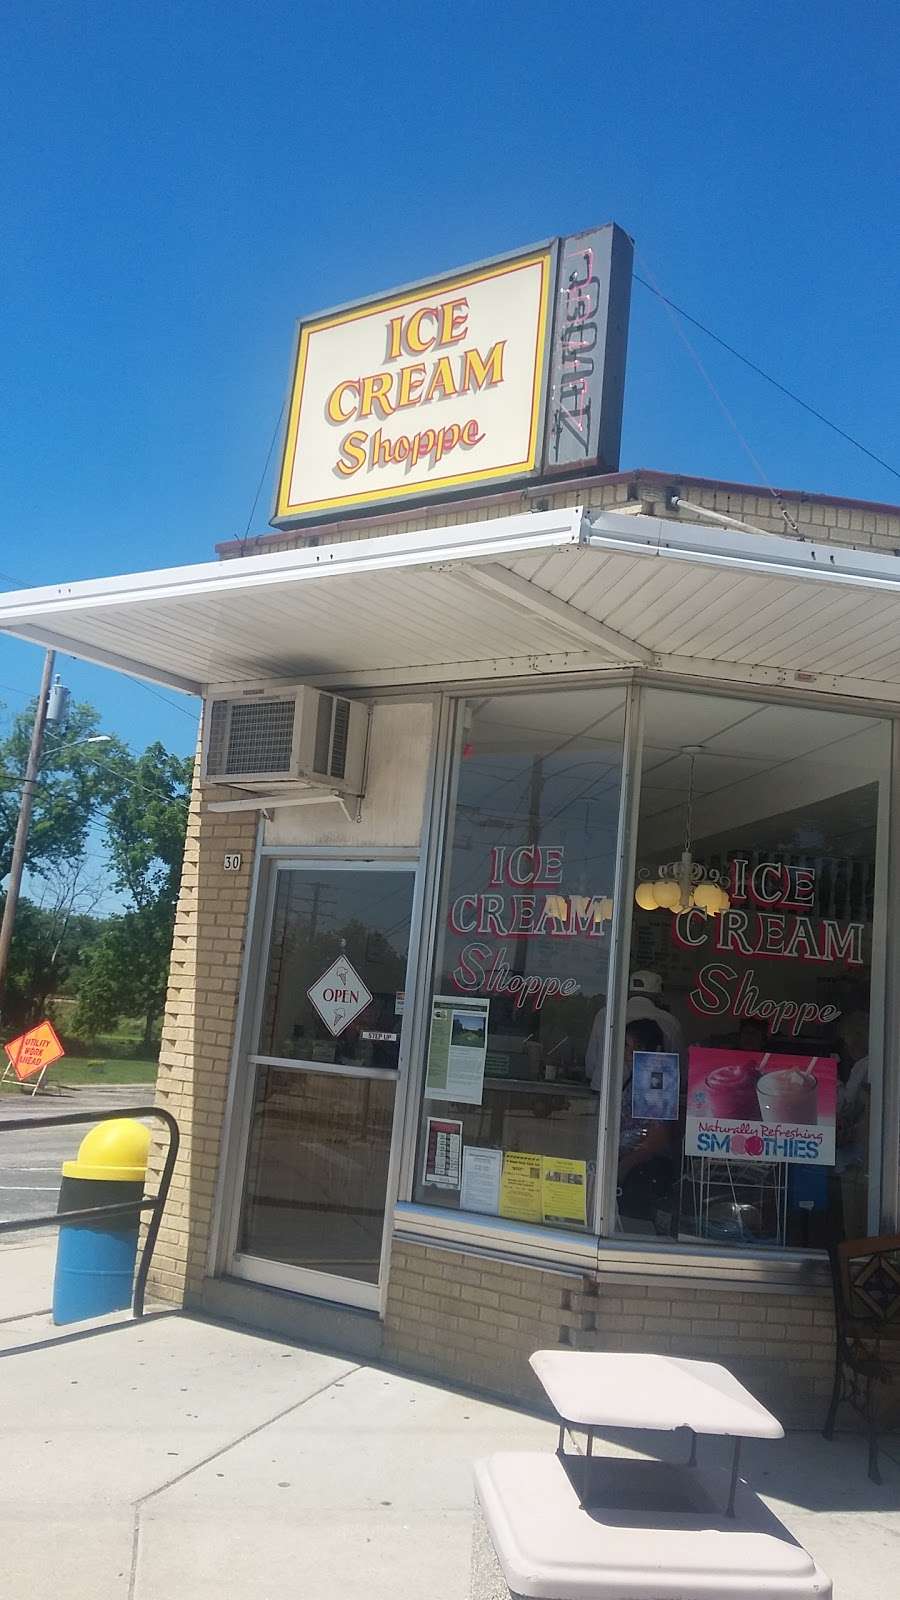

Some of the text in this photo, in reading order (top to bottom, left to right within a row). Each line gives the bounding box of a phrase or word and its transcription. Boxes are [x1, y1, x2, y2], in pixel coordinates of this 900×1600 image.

[382, 298, 470, 364] ICE
[325, 340, 508, 427] CREAM
[333, 419, 487, 479] Shoppe
[225, 856, 239, 869] 30
[488, 845, 565, 891] ICE
[731, 859, 816, 911] ICE
[449, 893, 612, 940] CREAM
[672, 903, 865, 966] CREAM
[322, 988, 359, 1004] OPEN
[449, 942, 581, 1010] Shoppe
[688, 963, 842, 1036] Shoppe
[19, 1056, 42, 1065] AHEAD
[24, 1048, 44, 1057] WORK
[25, 1039, 50, 1048] UTILITY
[697, 1132, 819, 1159] SMOOTHIES
[698, 1120, 824, 1144] Naturally Refreshing
